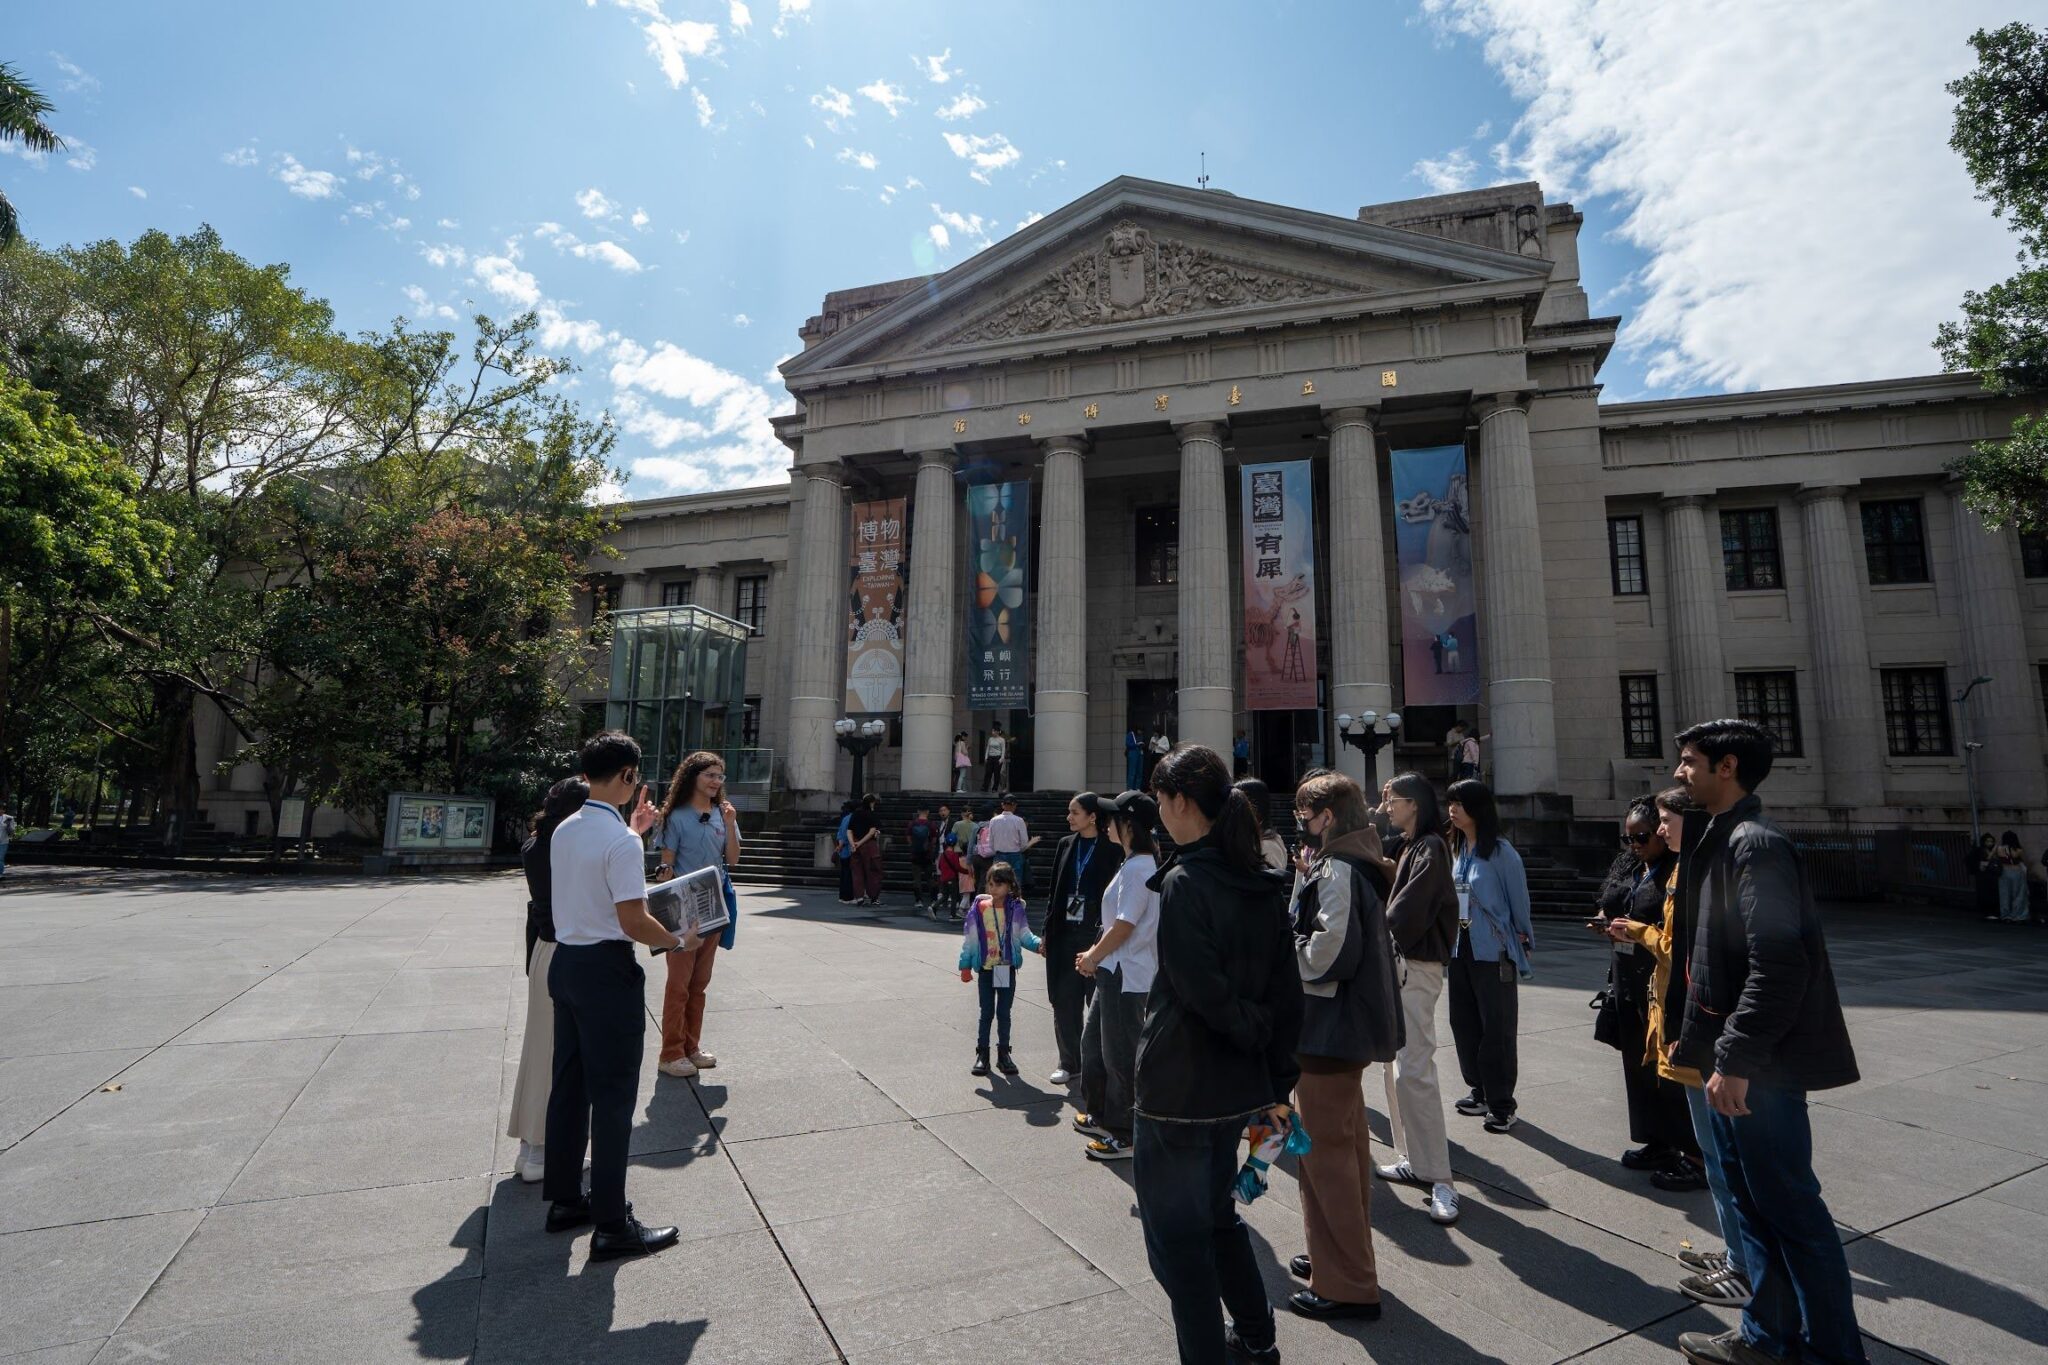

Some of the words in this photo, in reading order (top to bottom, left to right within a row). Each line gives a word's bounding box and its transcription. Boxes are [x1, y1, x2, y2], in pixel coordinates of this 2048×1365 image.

[953, 370, 1398, 433] 國立臺灣博物館
[858, 518, 900, 542] 博物
[857, 549, 900, 573] 臺灣
[983, 650, 1011, 663] 島嶼
[983, 669, 1011, 681] 飛行
